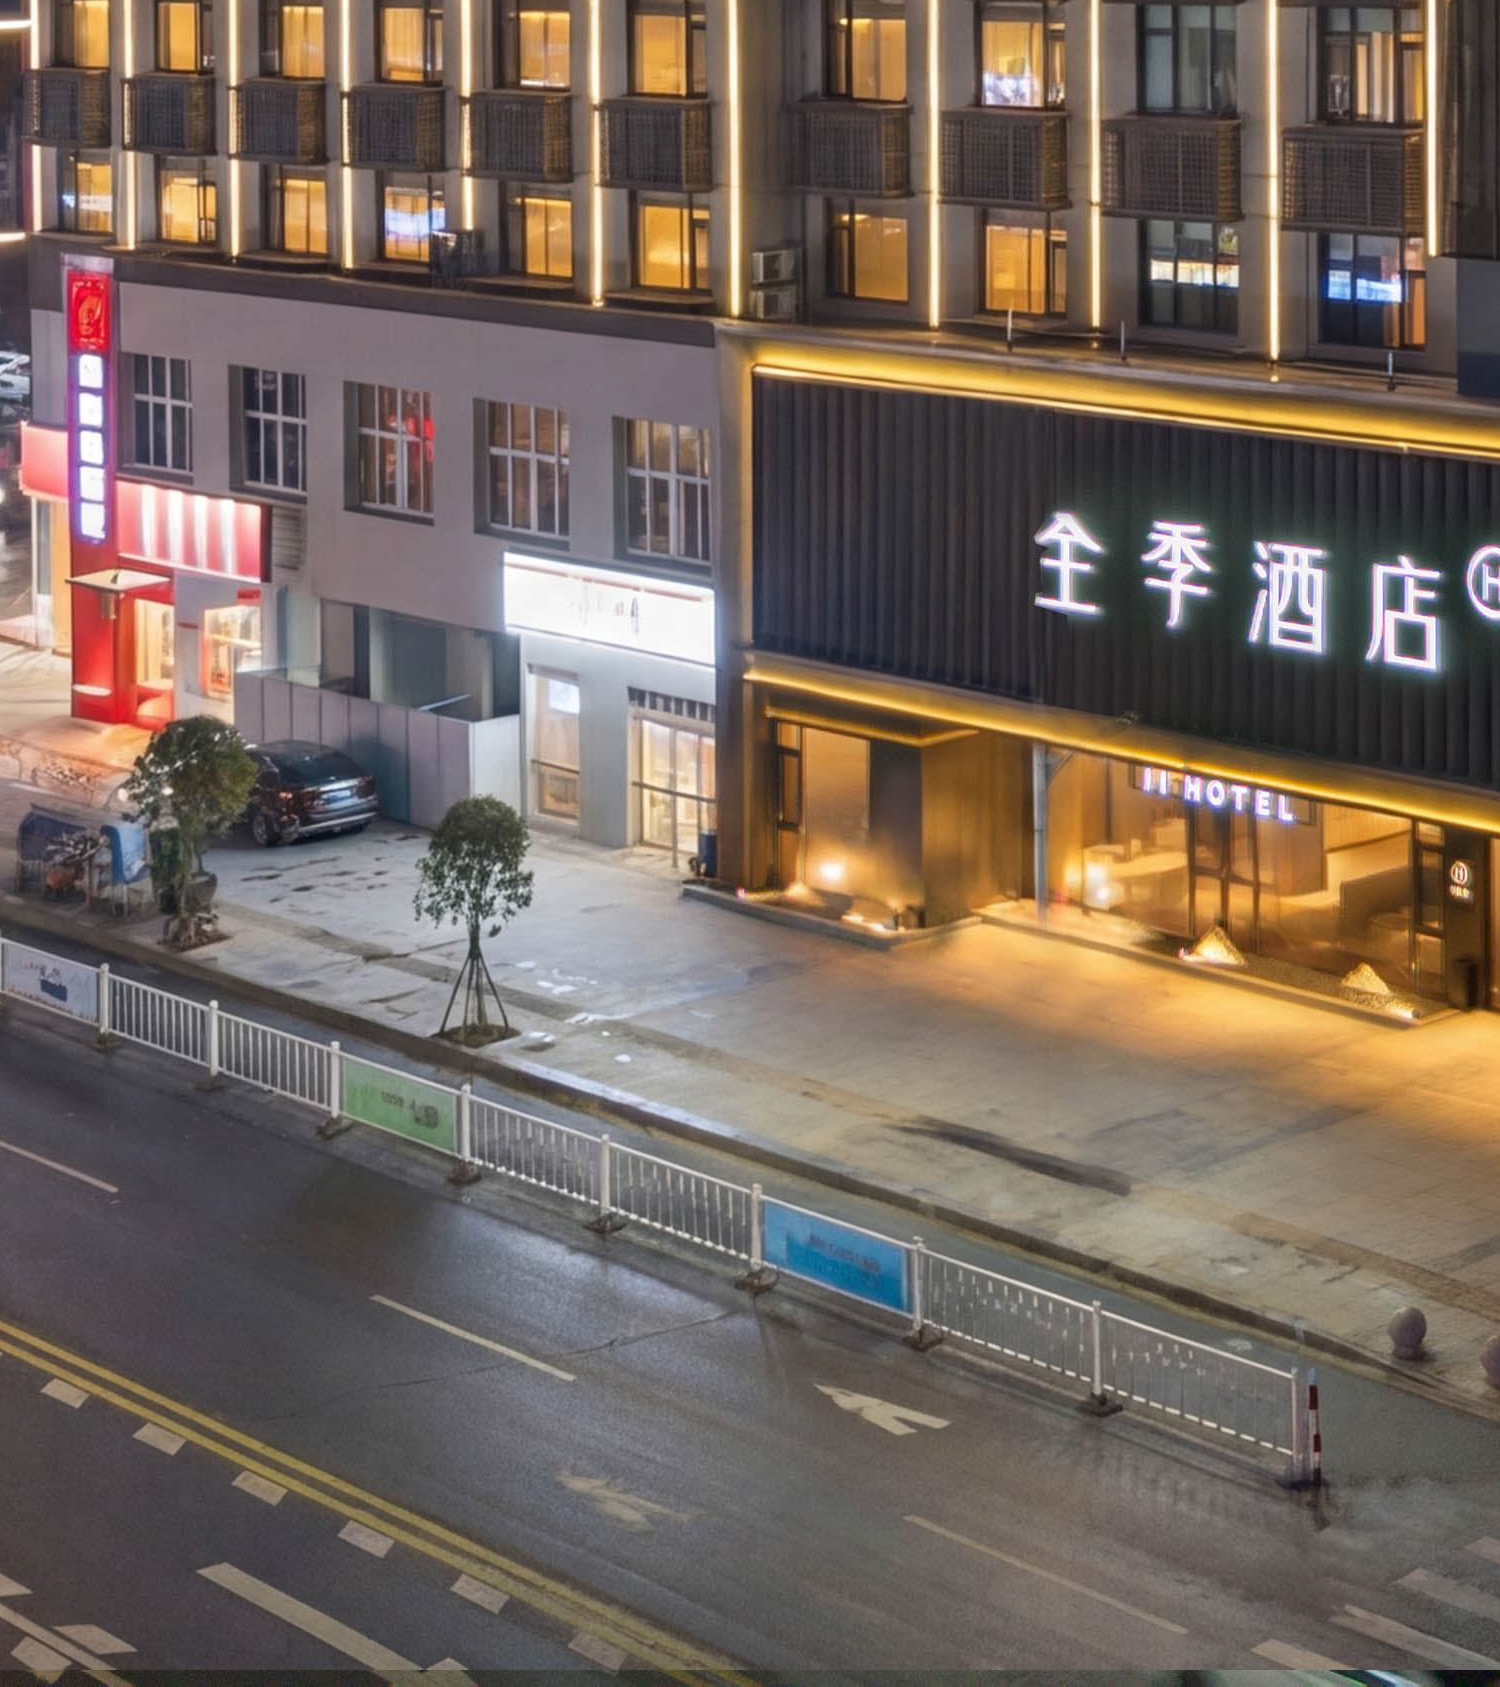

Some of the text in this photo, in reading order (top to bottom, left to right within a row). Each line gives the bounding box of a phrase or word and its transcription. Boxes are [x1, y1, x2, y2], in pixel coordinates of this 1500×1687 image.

[1034, 512, 1442, 671] 全季酒店
[1183, 774, 1294, 821] HOTEL
